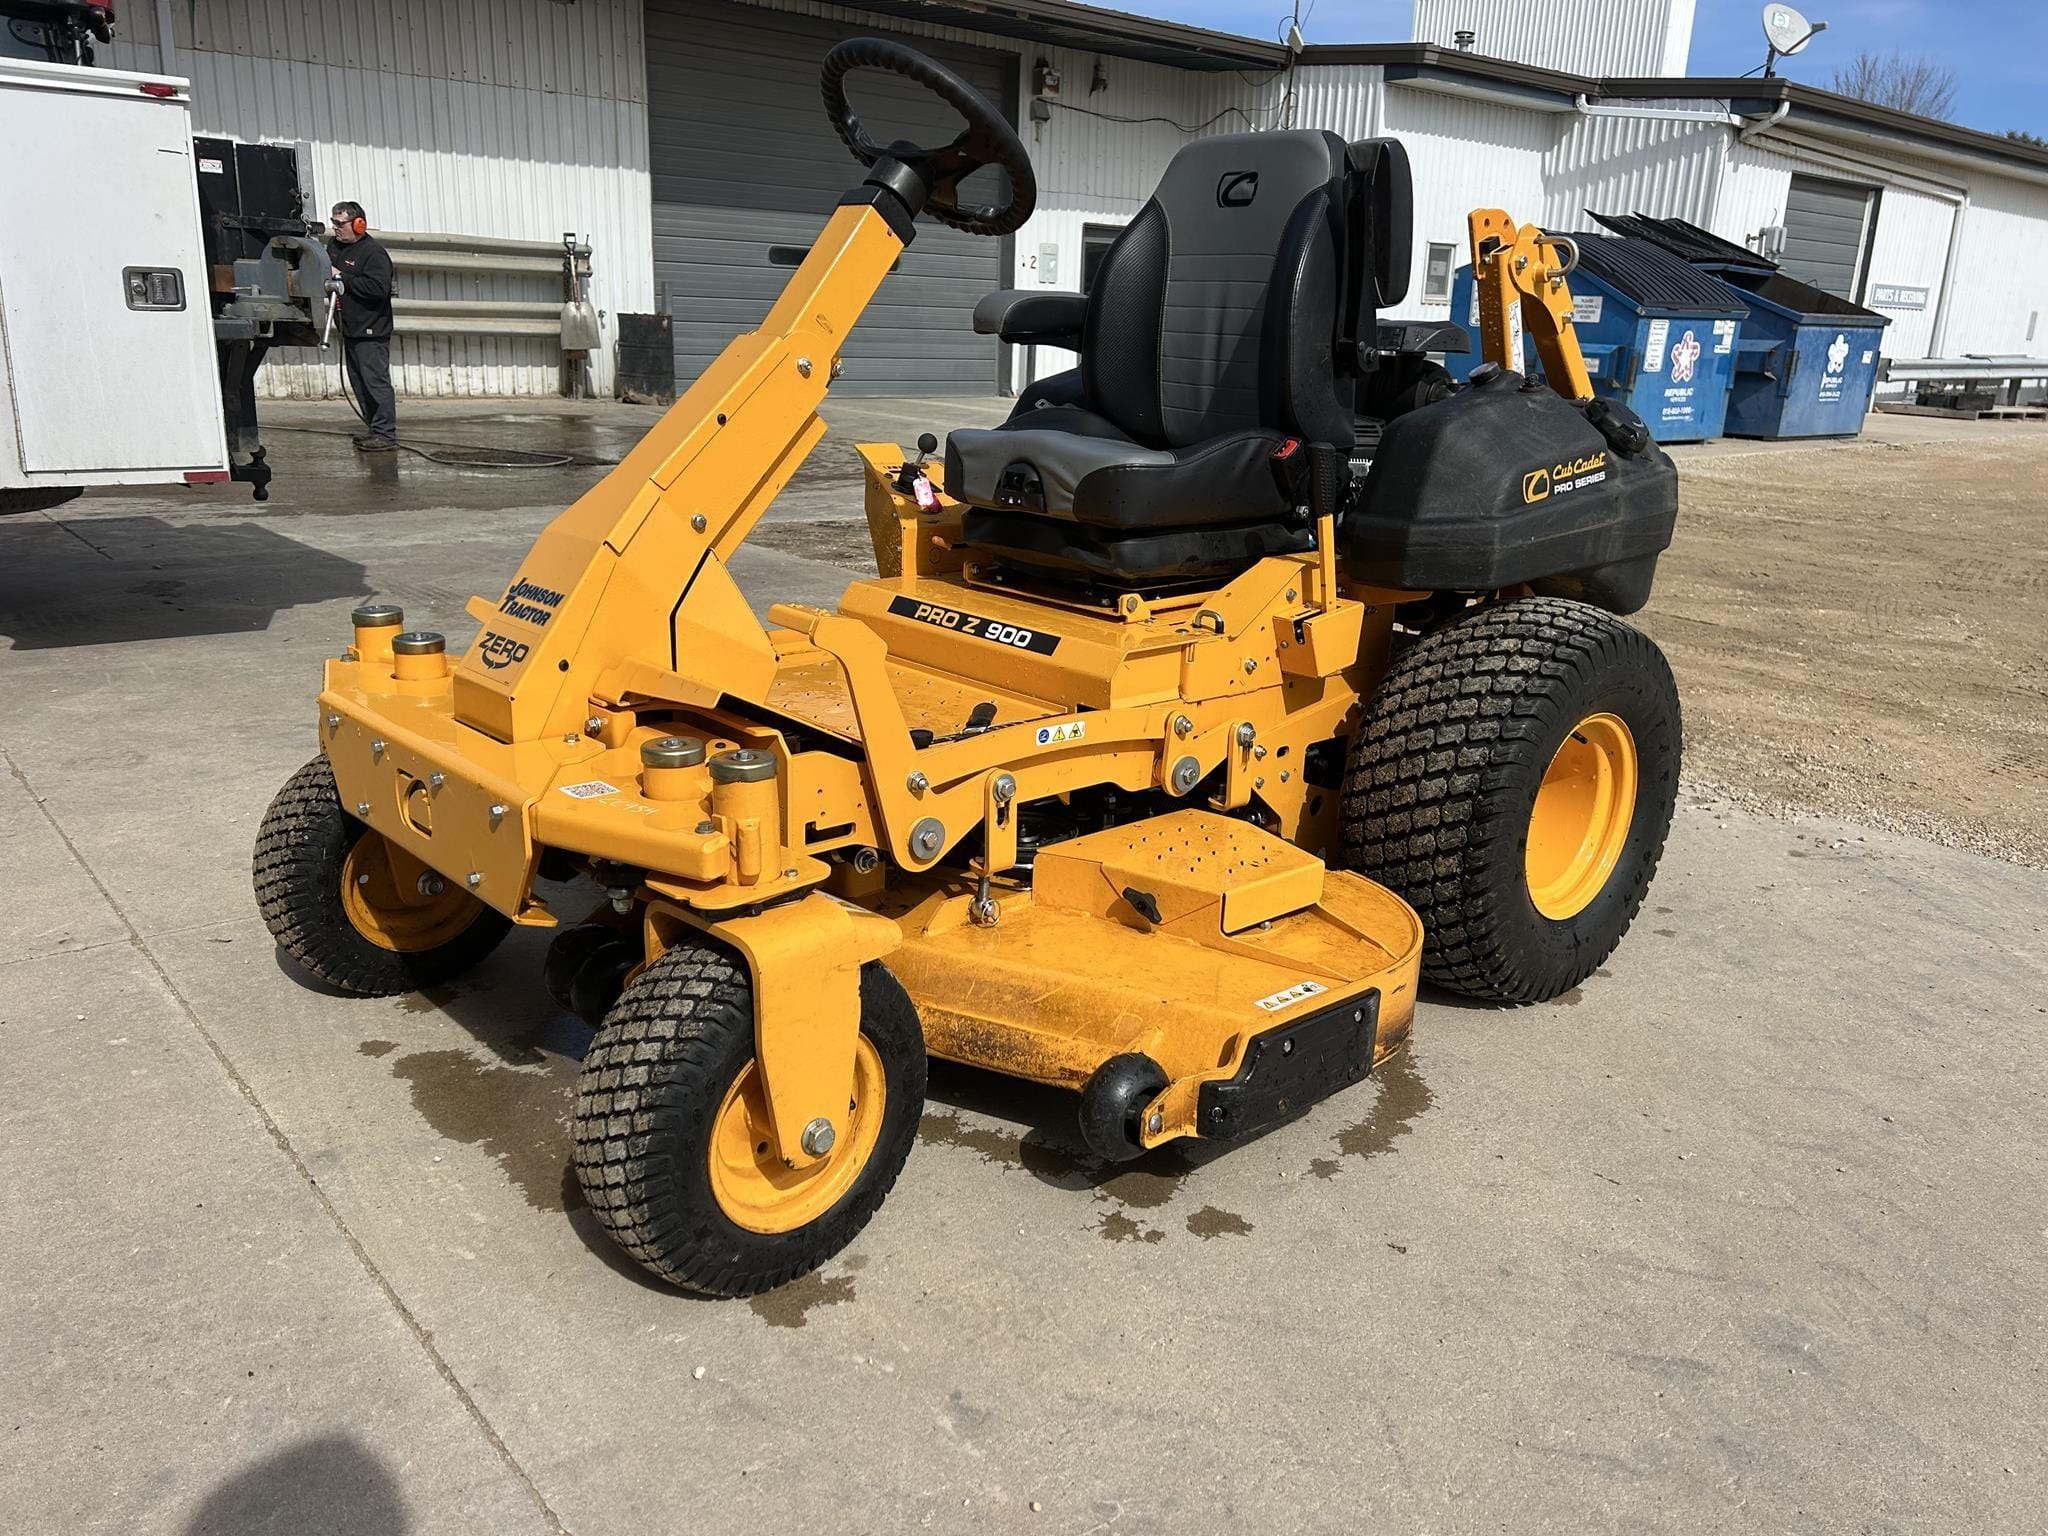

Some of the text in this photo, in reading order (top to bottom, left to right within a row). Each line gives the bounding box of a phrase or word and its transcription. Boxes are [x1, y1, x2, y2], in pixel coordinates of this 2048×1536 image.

[1874, 288, 1894, 302] PARTS
[1664, 387, 1694, 397] REPUBLIC
[1553, 451, 1606, 480] Cub Cadet
[1554, 471, 1606, 495] PRO SERIES
[508, 577, 565, 608] JOHNSON
[498, 594, 551, 626] TRACTOR
[914, 604, 1032, 648] PRO Z 900
[478, 631, 530, 663] ZERO
